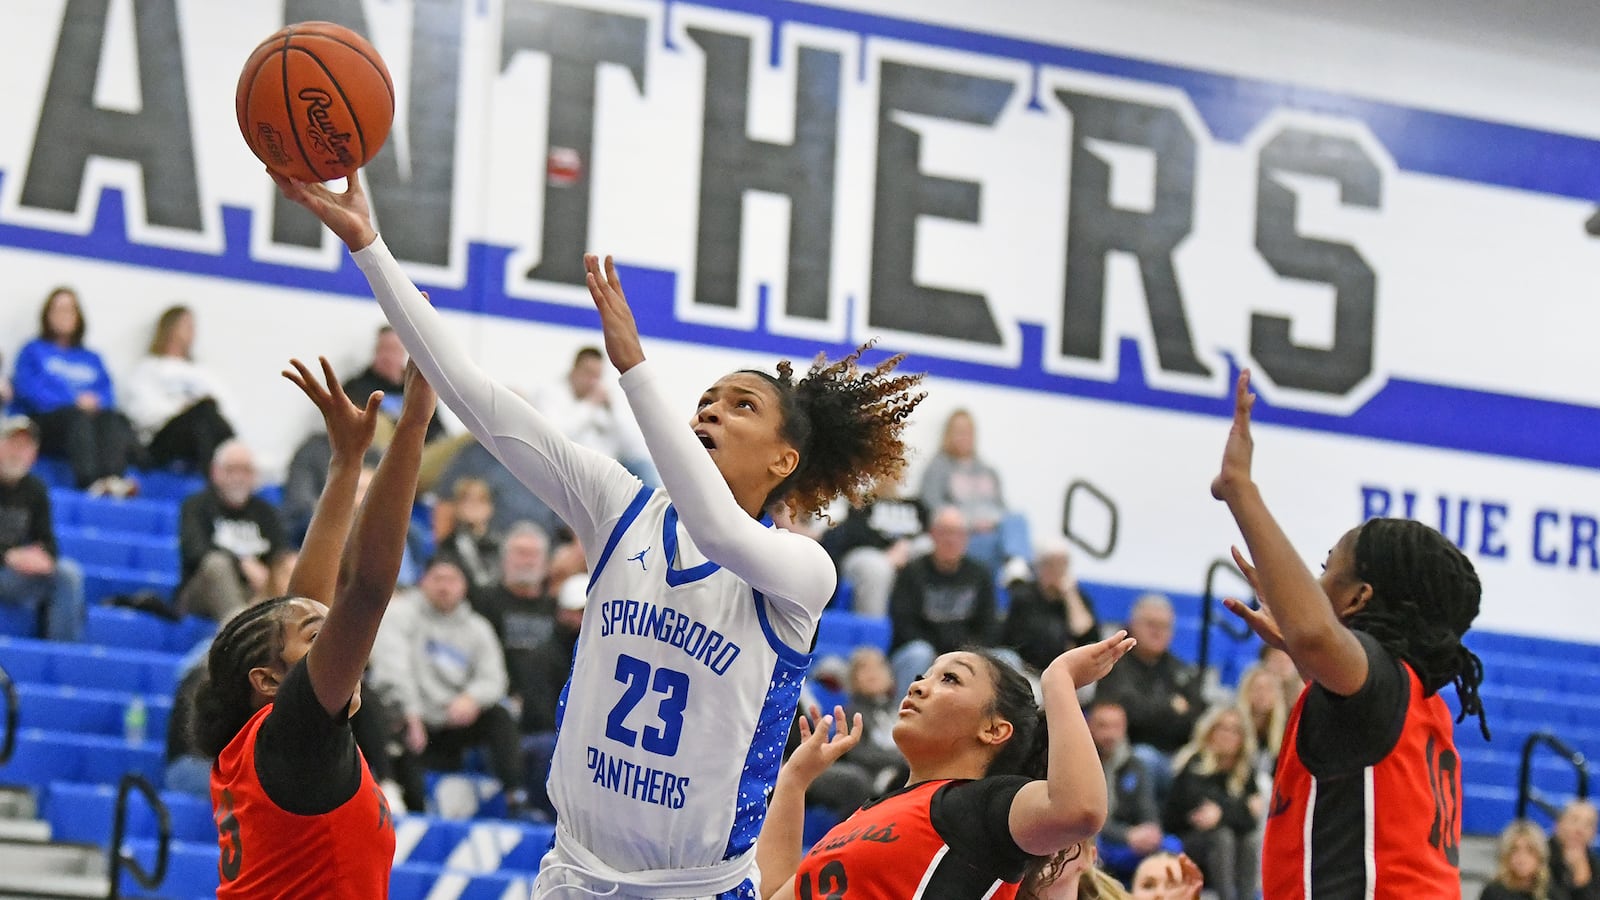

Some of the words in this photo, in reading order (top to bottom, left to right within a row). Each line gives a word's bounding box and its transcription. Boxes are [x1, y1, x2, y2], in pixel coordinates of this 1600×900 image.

[601, 599, 741, 677] SPRINGBORO
[605, 653, 690, 757] 23
[587, 746, 690, 810] PANTHERS
